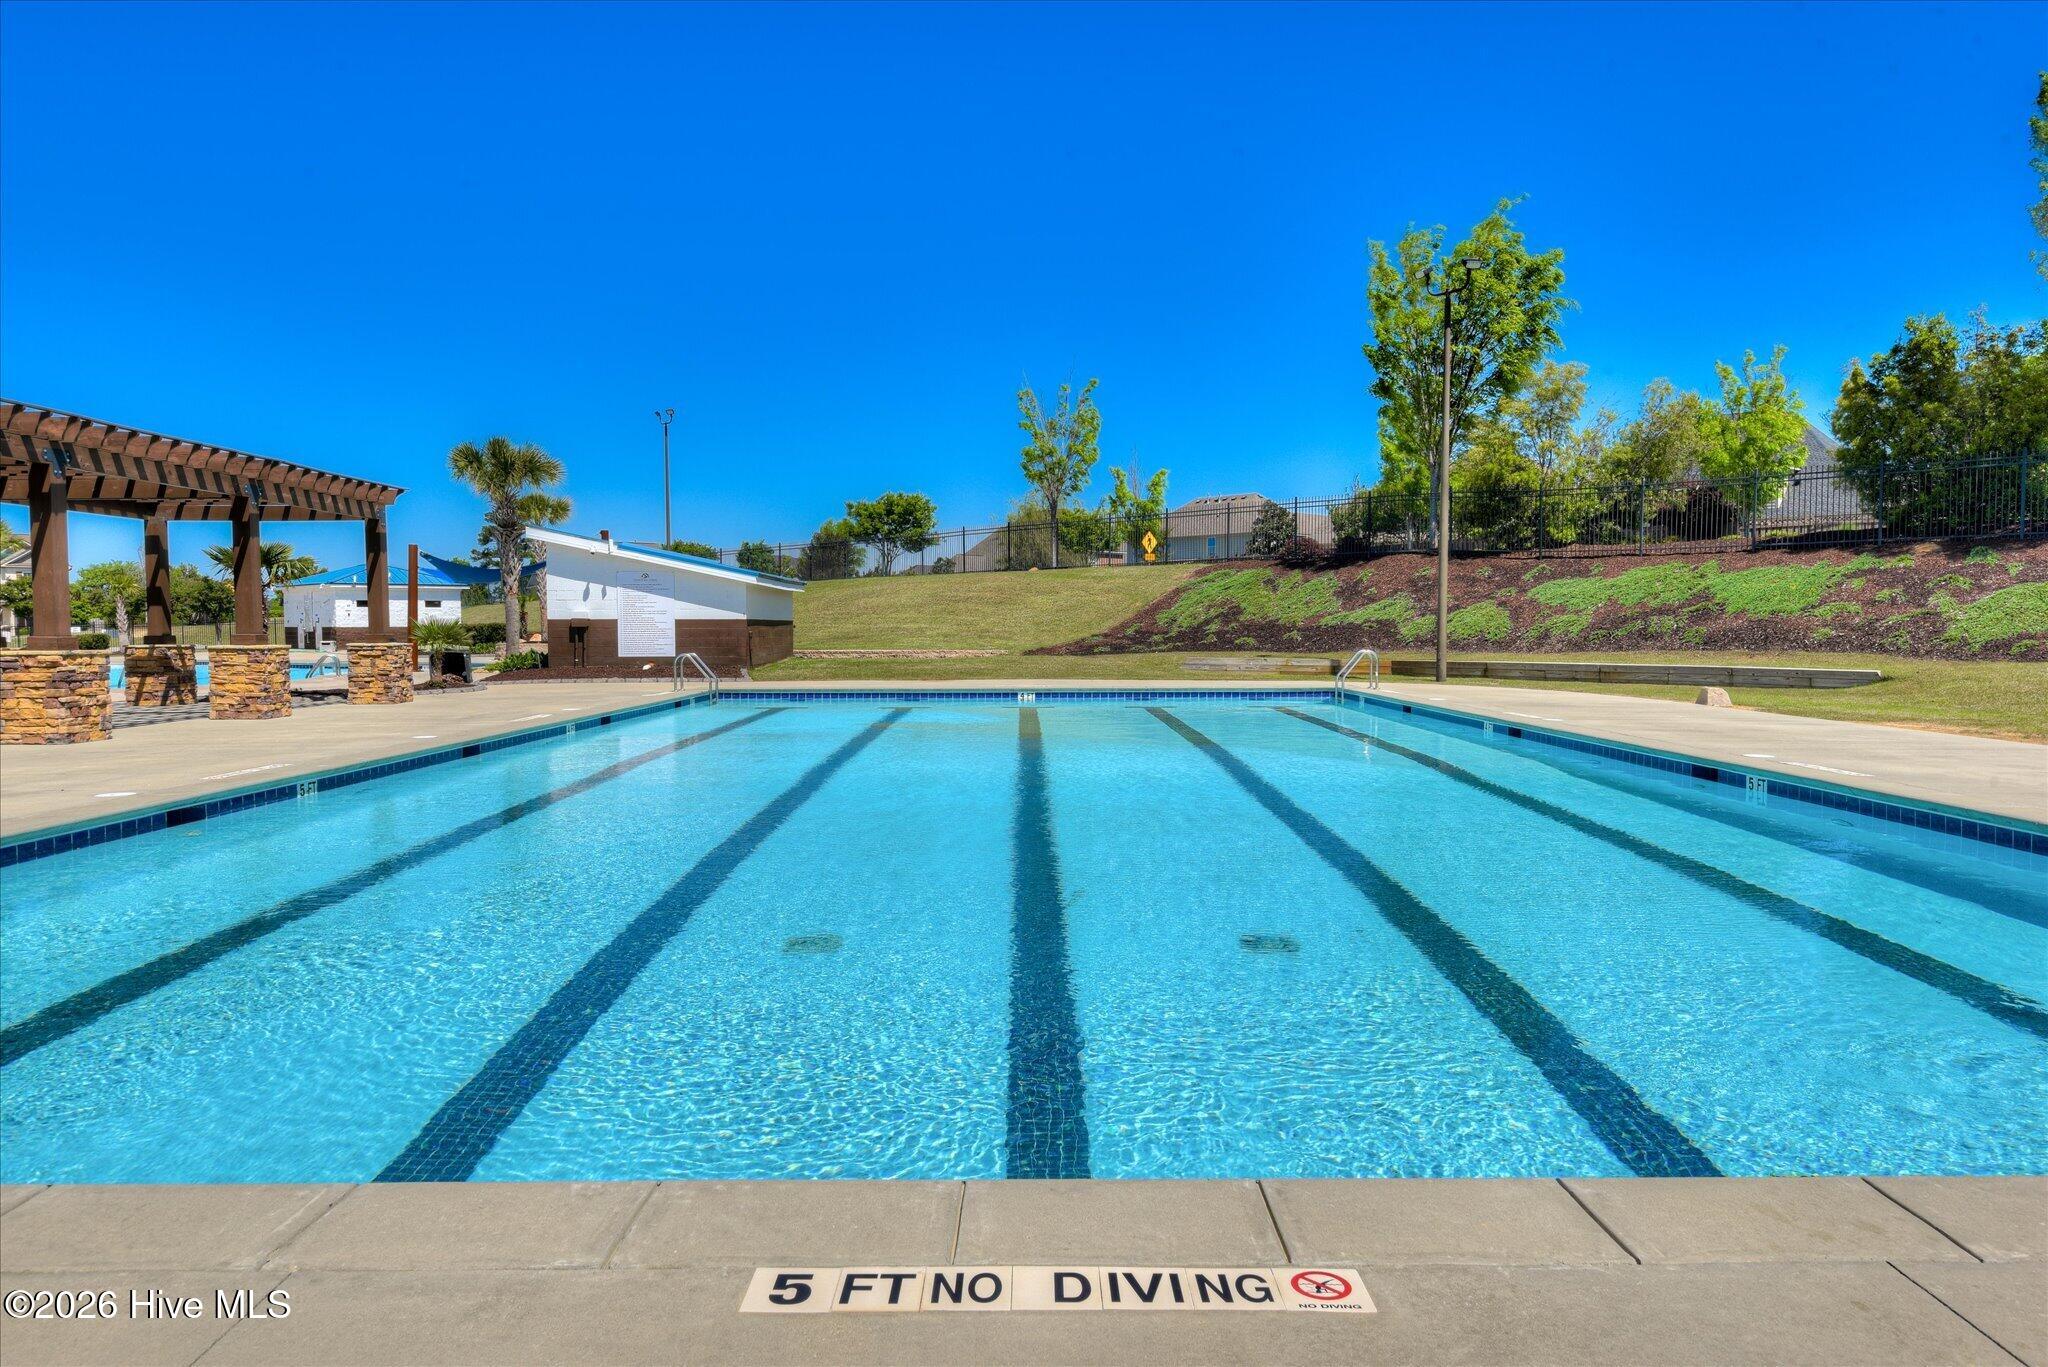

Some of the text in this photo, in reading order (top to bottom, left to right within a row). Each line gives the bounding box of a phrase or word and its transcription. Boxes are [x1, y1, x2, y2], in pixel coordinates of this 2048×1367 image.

[300, 781, 316, 796] 5 FT
[1749, 777, 1766, 792] 5 FT
[768, 1272, 1275, 1305] 5 FT NO DIVING
